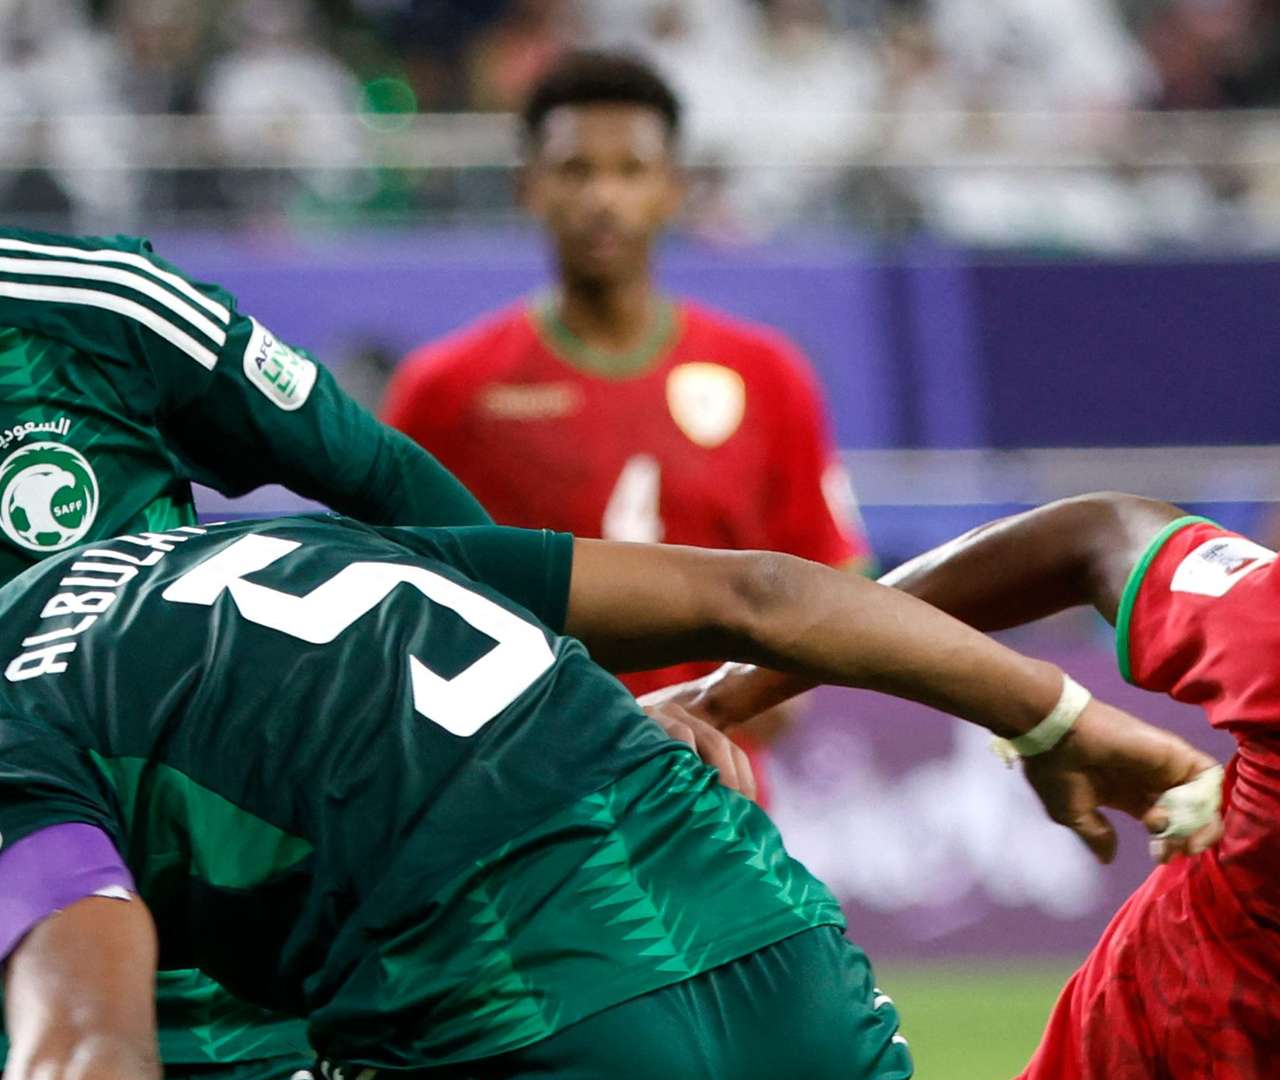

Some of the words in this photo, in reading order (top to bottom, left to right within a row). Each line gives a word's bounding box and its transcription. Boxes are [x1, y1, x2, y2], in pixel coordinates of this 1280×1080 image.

[255, 335, 273, 371] AFC
[53, 500, 82, 517] SAFF
[162, 533, 556, 738] 5
